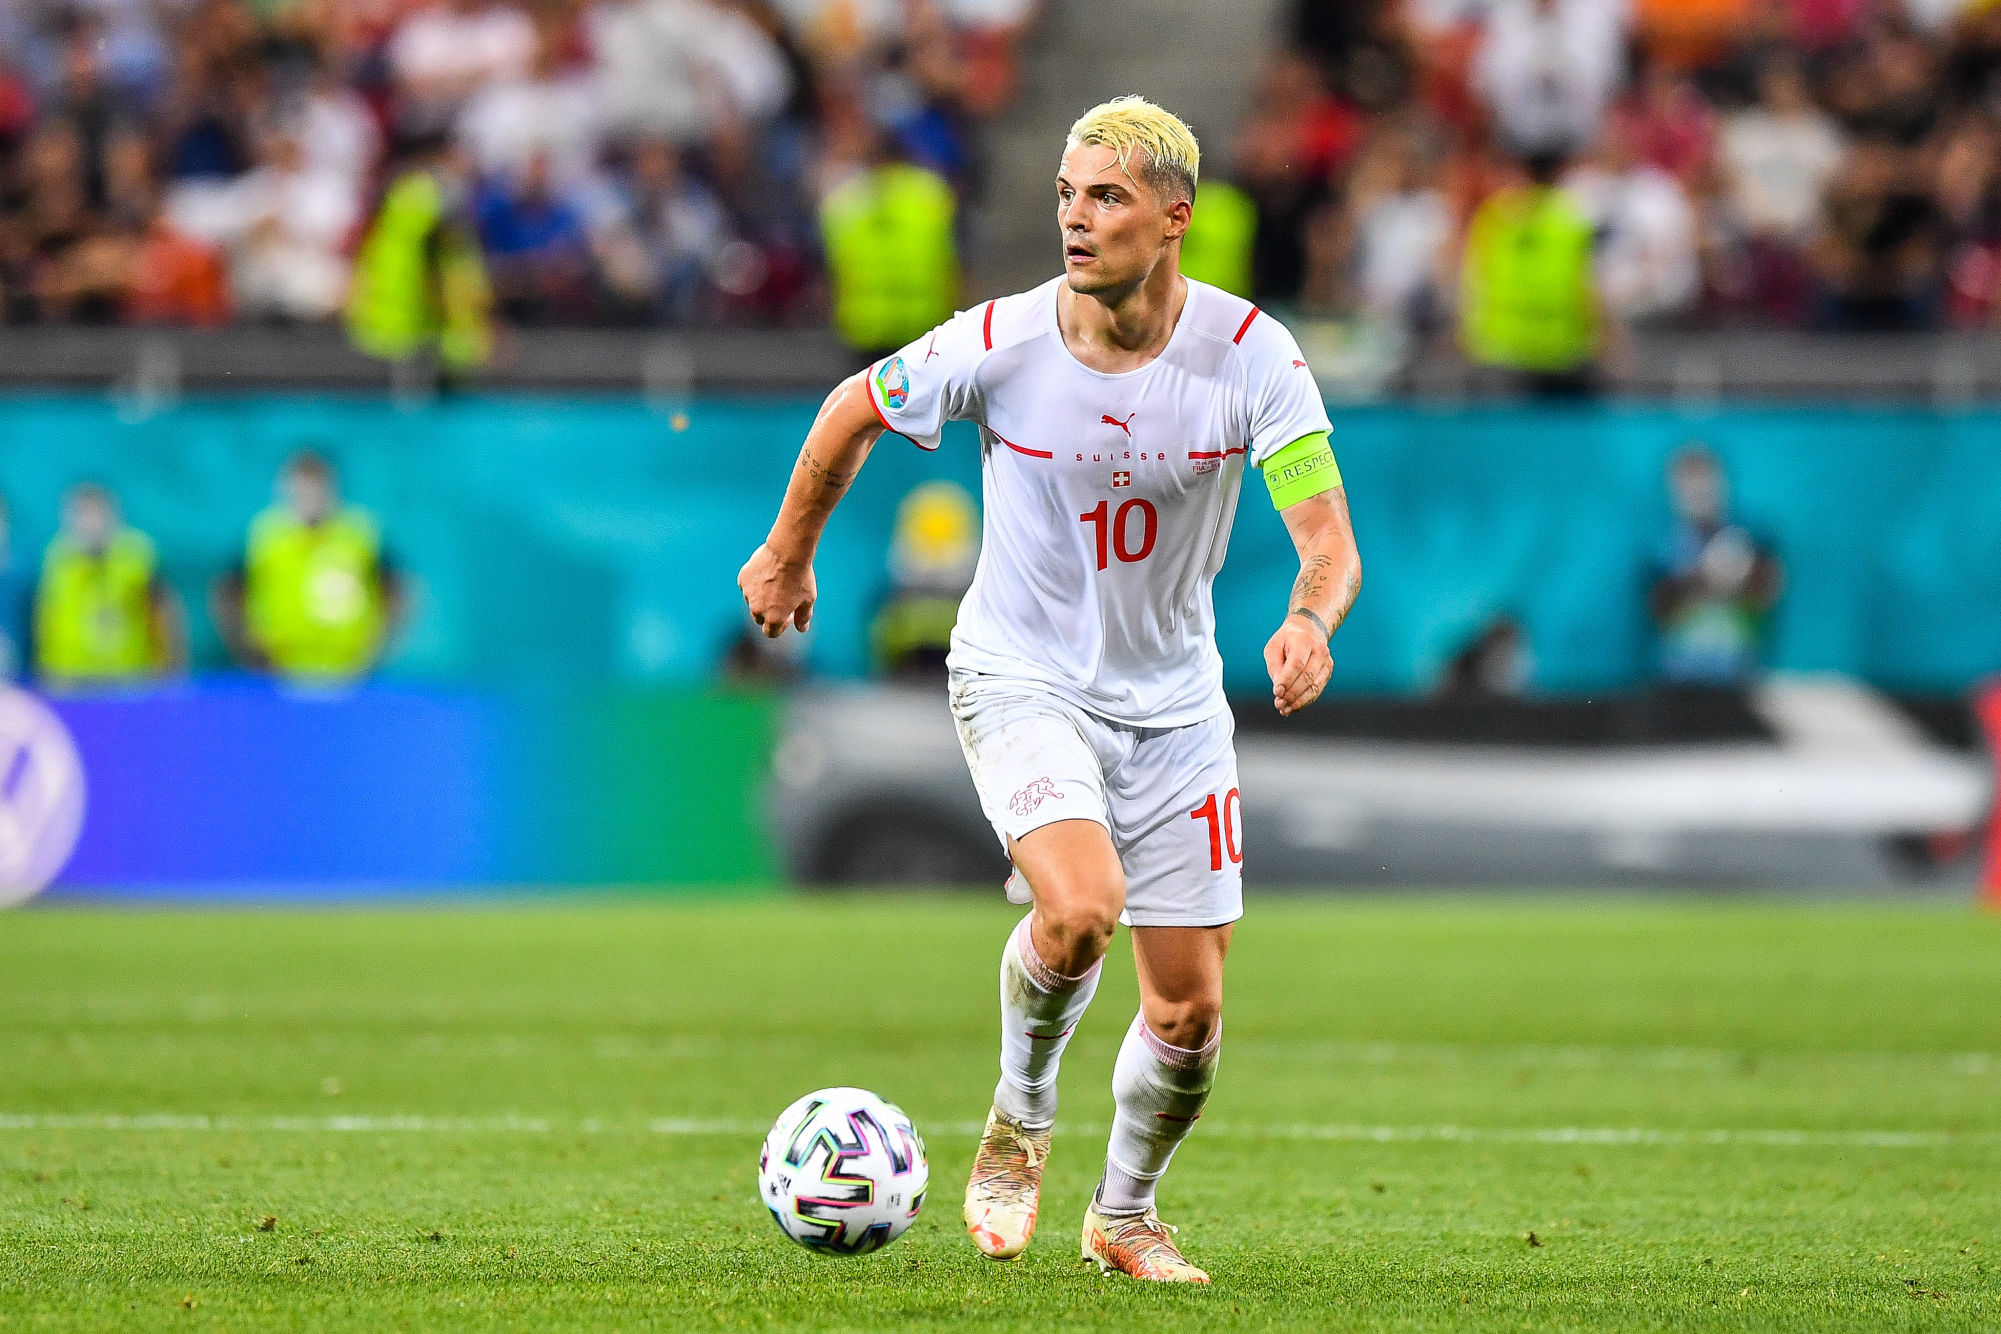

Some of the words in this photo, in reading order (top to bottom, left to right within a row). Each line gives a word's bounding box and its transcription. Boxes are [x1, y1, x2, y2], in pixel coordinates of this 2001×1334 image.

[1076, 451, 1165, 462] suisse
[1283, 451, 1332, 481] RESPECT
[1080, 498, 1158, 571] 10
[1190, 787, 1242, 871] 10
